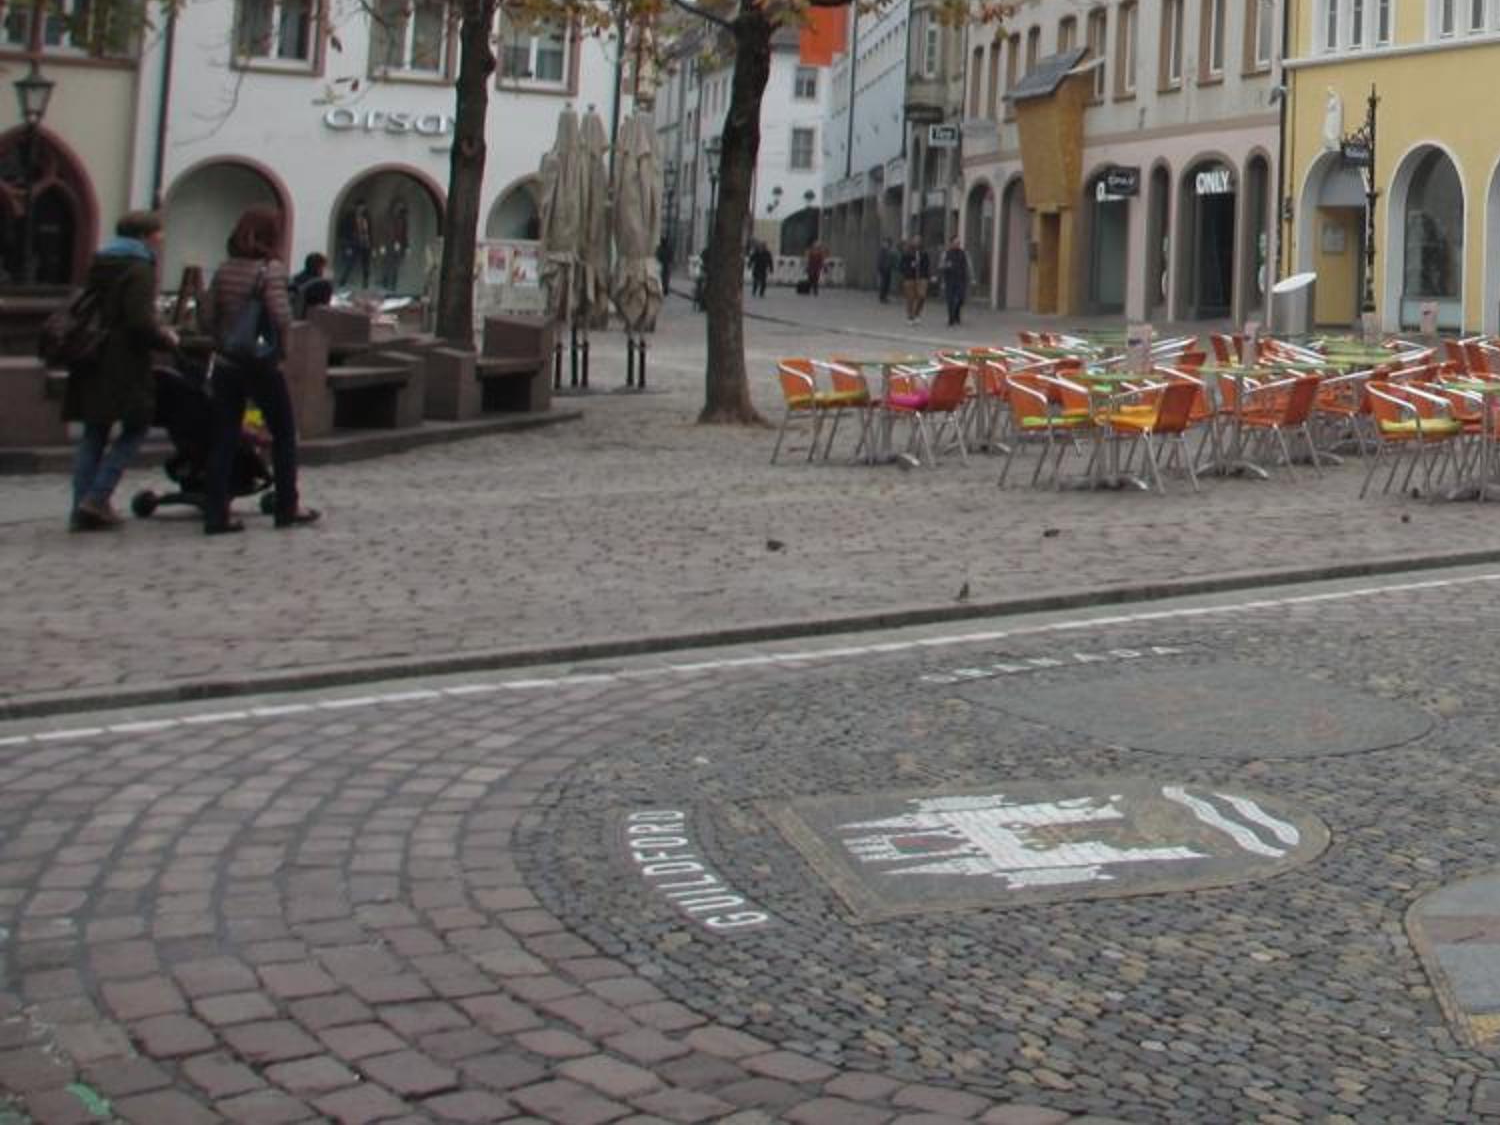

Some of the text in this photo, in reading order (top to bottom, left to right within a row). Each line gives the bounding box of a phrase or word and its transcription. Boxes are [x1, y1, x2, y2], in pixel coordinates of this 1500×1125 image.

[323, 106, 457, 143] orsa
[1195, 170, 1231, 195] ONLY
[628, 810, 769, 928] GUILDFORD
